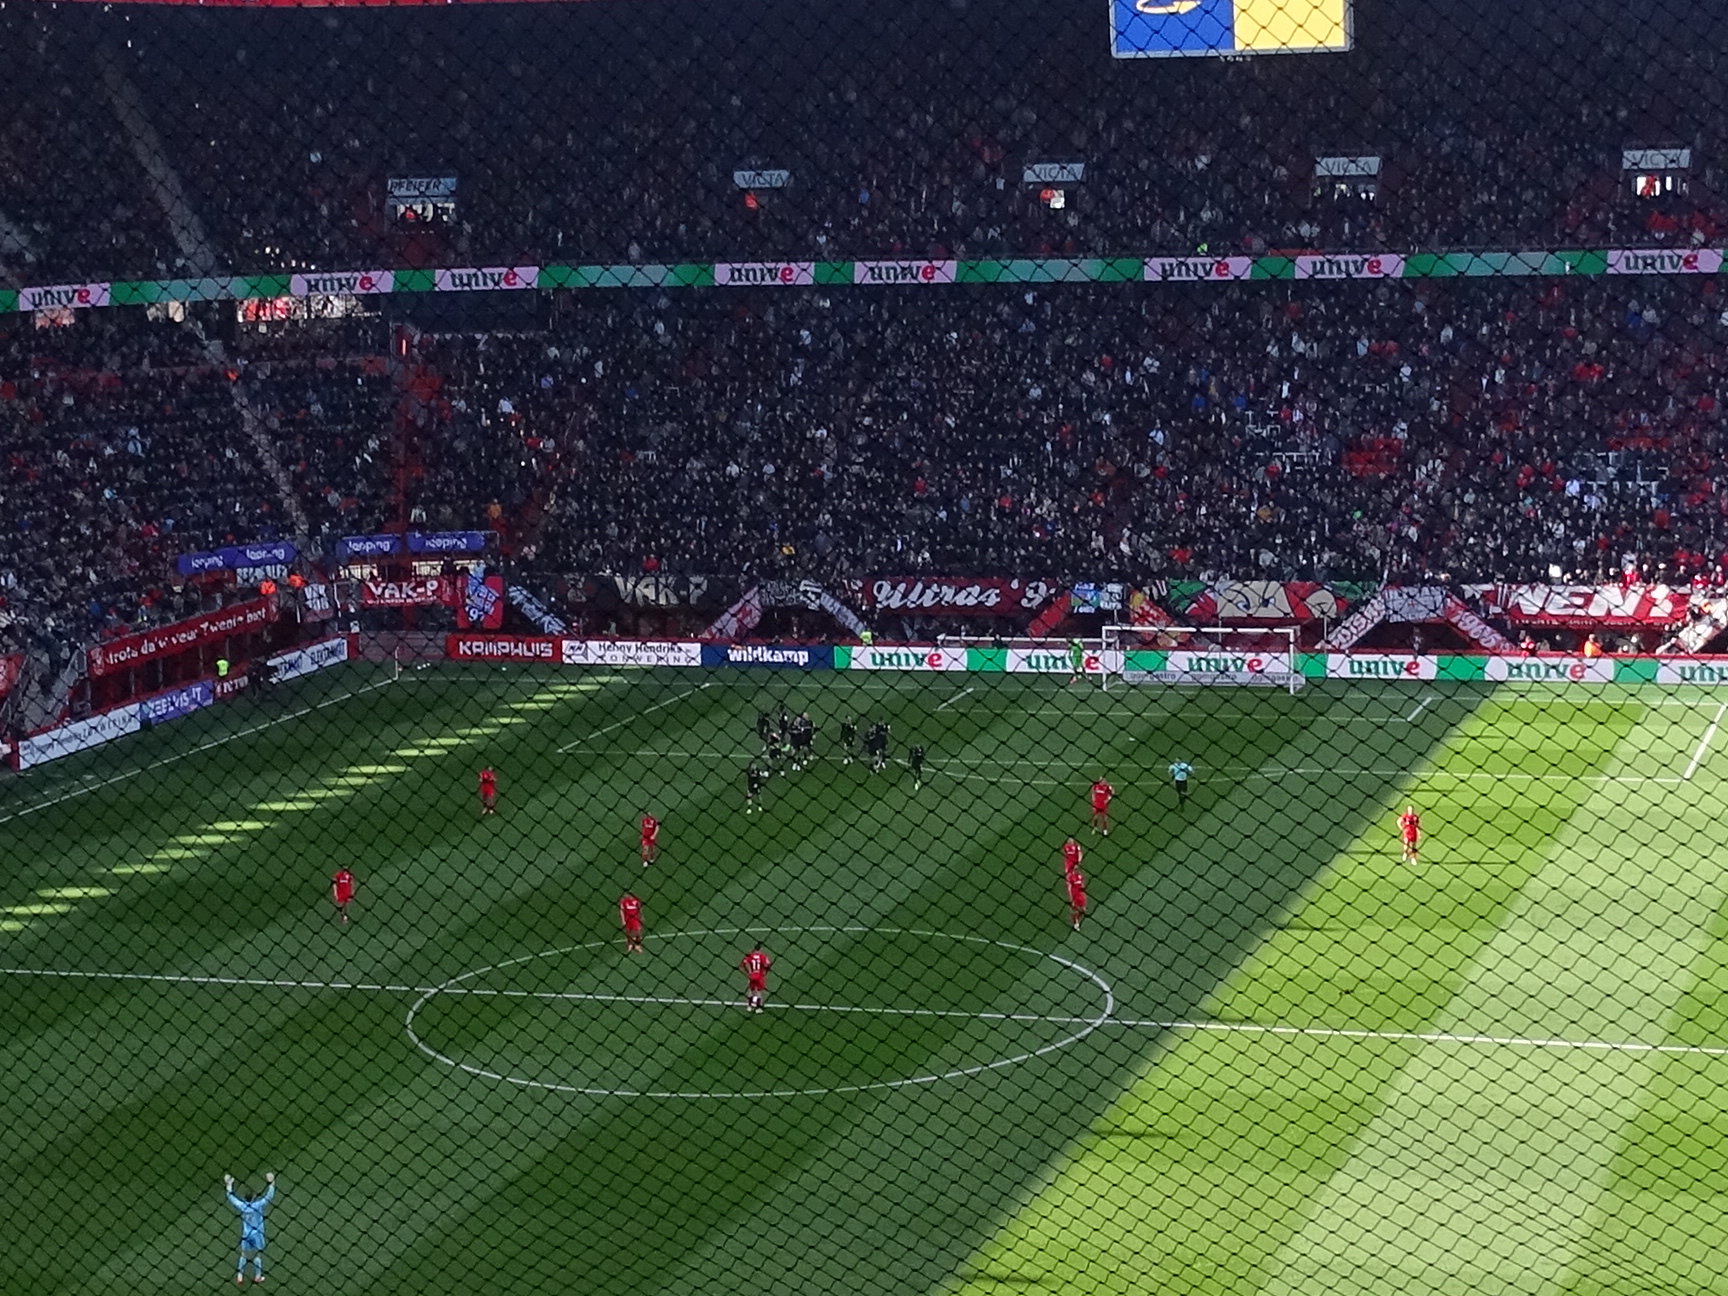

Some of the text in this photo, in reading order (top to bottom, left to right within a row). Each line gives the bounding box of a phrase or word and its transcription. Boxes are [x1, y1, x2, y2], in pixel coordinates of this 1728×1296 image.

[367, 580, 439, 599] VAK-P
[458, 640, 553, 658] KAMPHUIS
[727, 646, 809, 665] wildkamp
